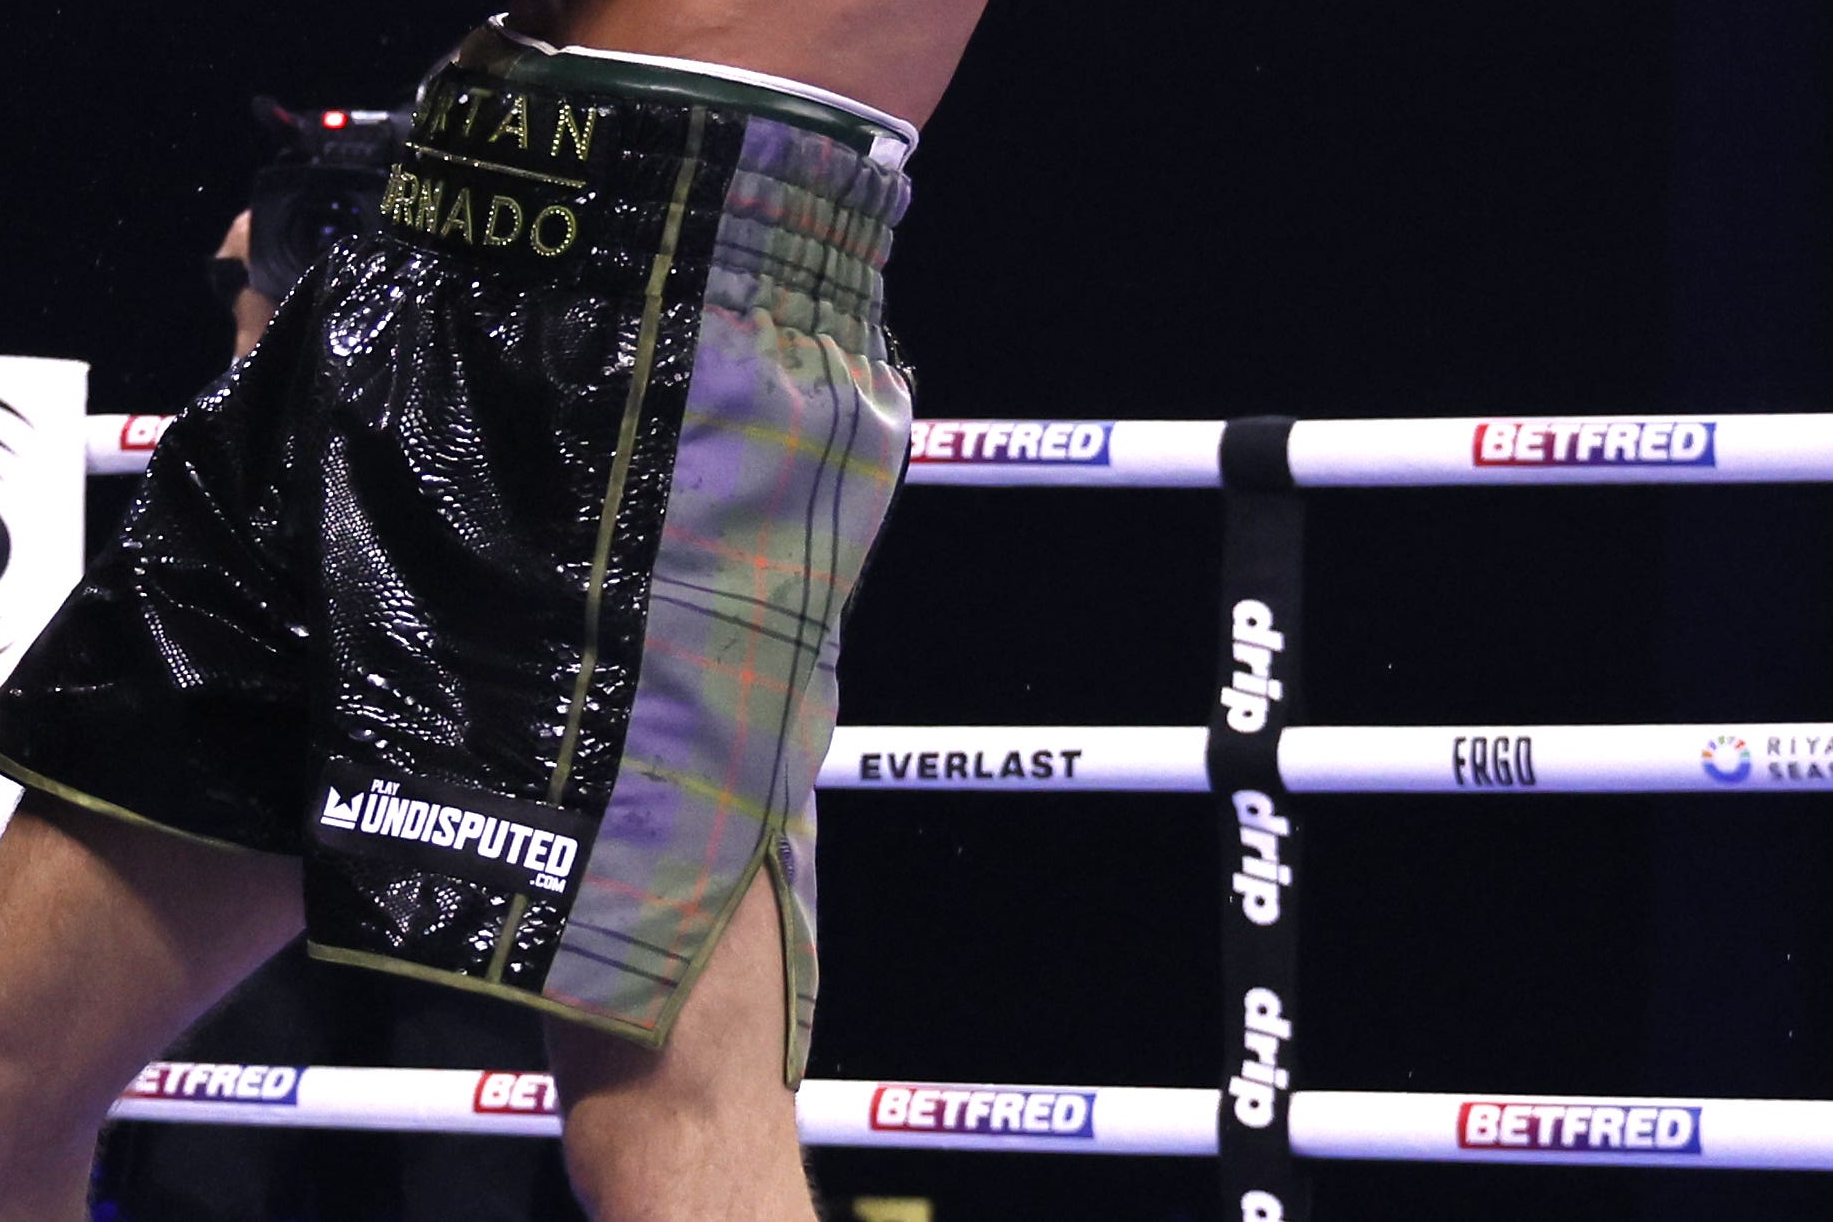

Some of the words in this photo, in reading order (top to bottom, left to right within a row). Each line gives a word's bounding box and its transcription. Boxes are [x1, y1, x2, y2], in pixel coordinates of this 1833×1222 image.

[911, 422, 1105, 460] BETFRED
[1481, 423, 1709, 462] BETFRED
[1220, 598, 1285, 733] drip
[370, 778, 401, 797] PLAY
[860, 750, 1082, 780] EVERLAST
[360, 793, 578, 878] UNDISPUTED
[1231, 789, 1293, 926] drip
[529, 873, 567, 894] .COM
[1229, 986, 1293, 1129] drip
[876, 1088, 1088, 1133] BETFRED
[1467, 1103, 1695, 1149] BETFRED
